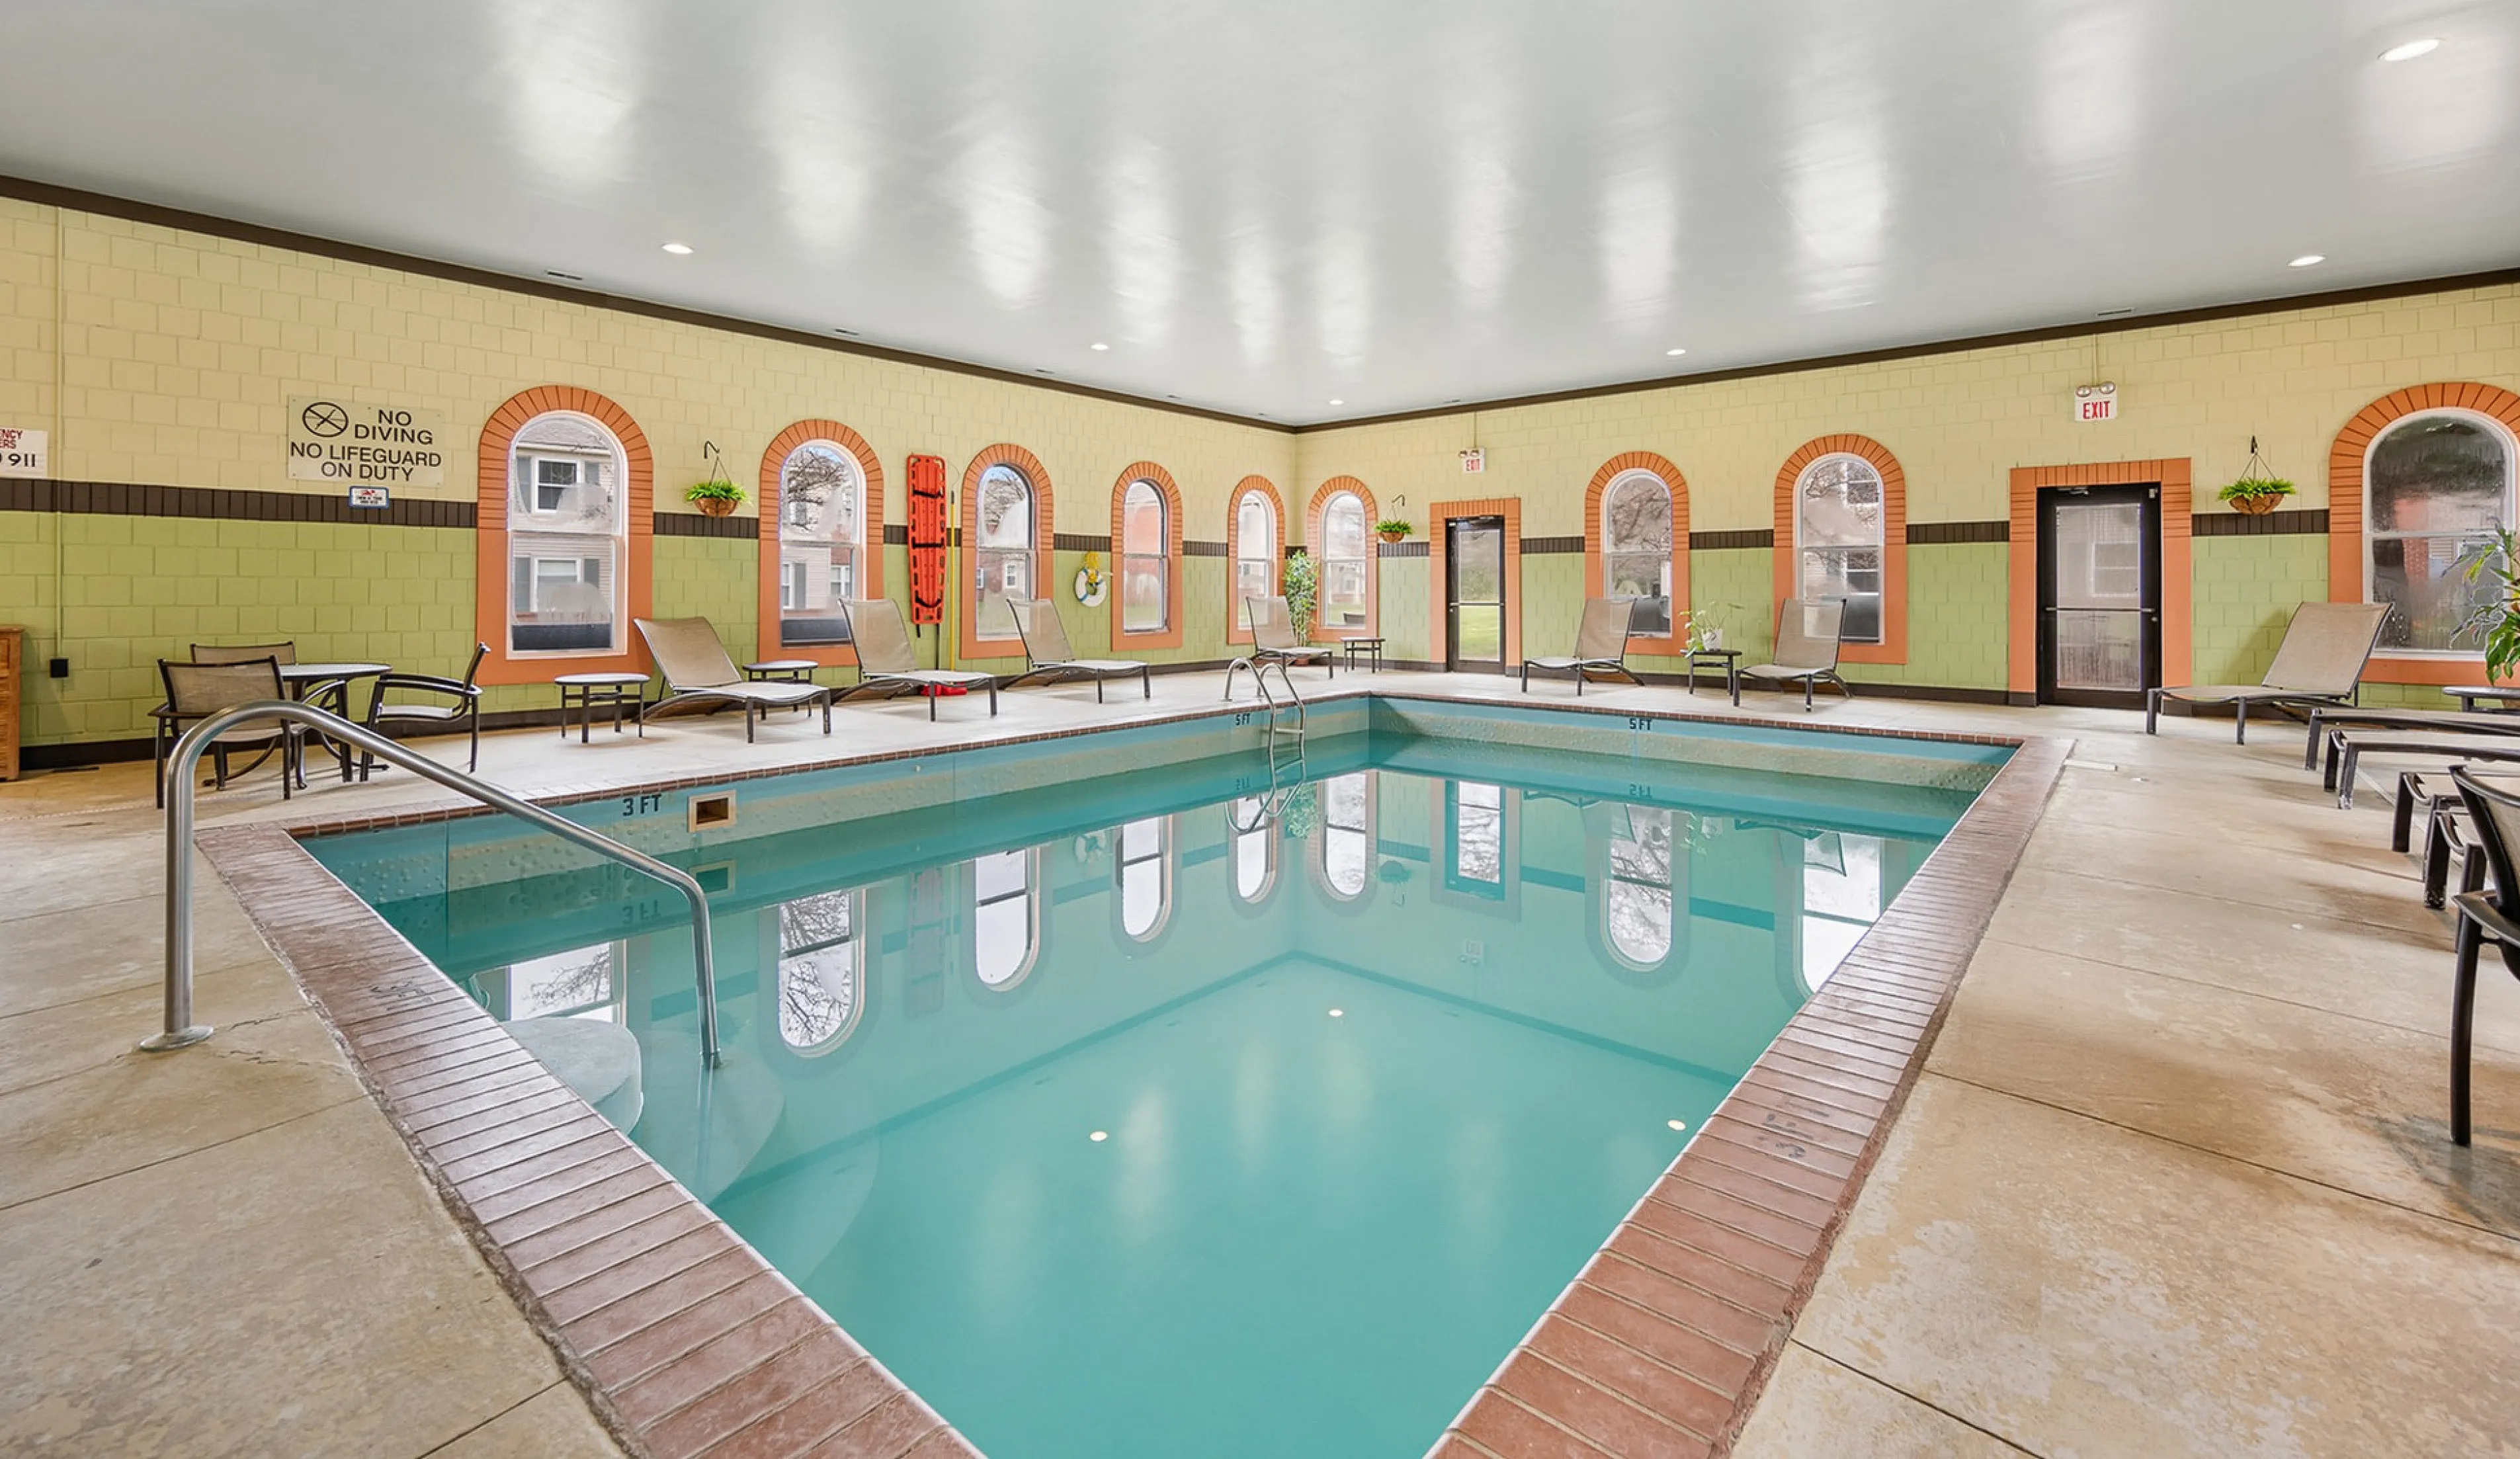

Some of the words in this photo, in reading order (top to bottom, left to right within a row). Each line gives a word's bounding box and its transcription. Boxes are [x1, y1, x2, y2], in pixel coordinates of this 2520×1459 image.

[378, 409, 412, 426] NO
[2083, 400, 2111, 419] EXIT
[355, 424, 433, 445] DIVING
[8, 453, 36, 468] 911
[290, 441, 322, 458] NO
[329, 444, 441, 467] LIFEGUARD
[321, 461, 352, 478] ON
[359, 464, 414, 481] DUTY
[1466, 458, 1480, 472] EXIT
[622, 798, 633, 817] 3
[640, 794, 662, 815] FT
